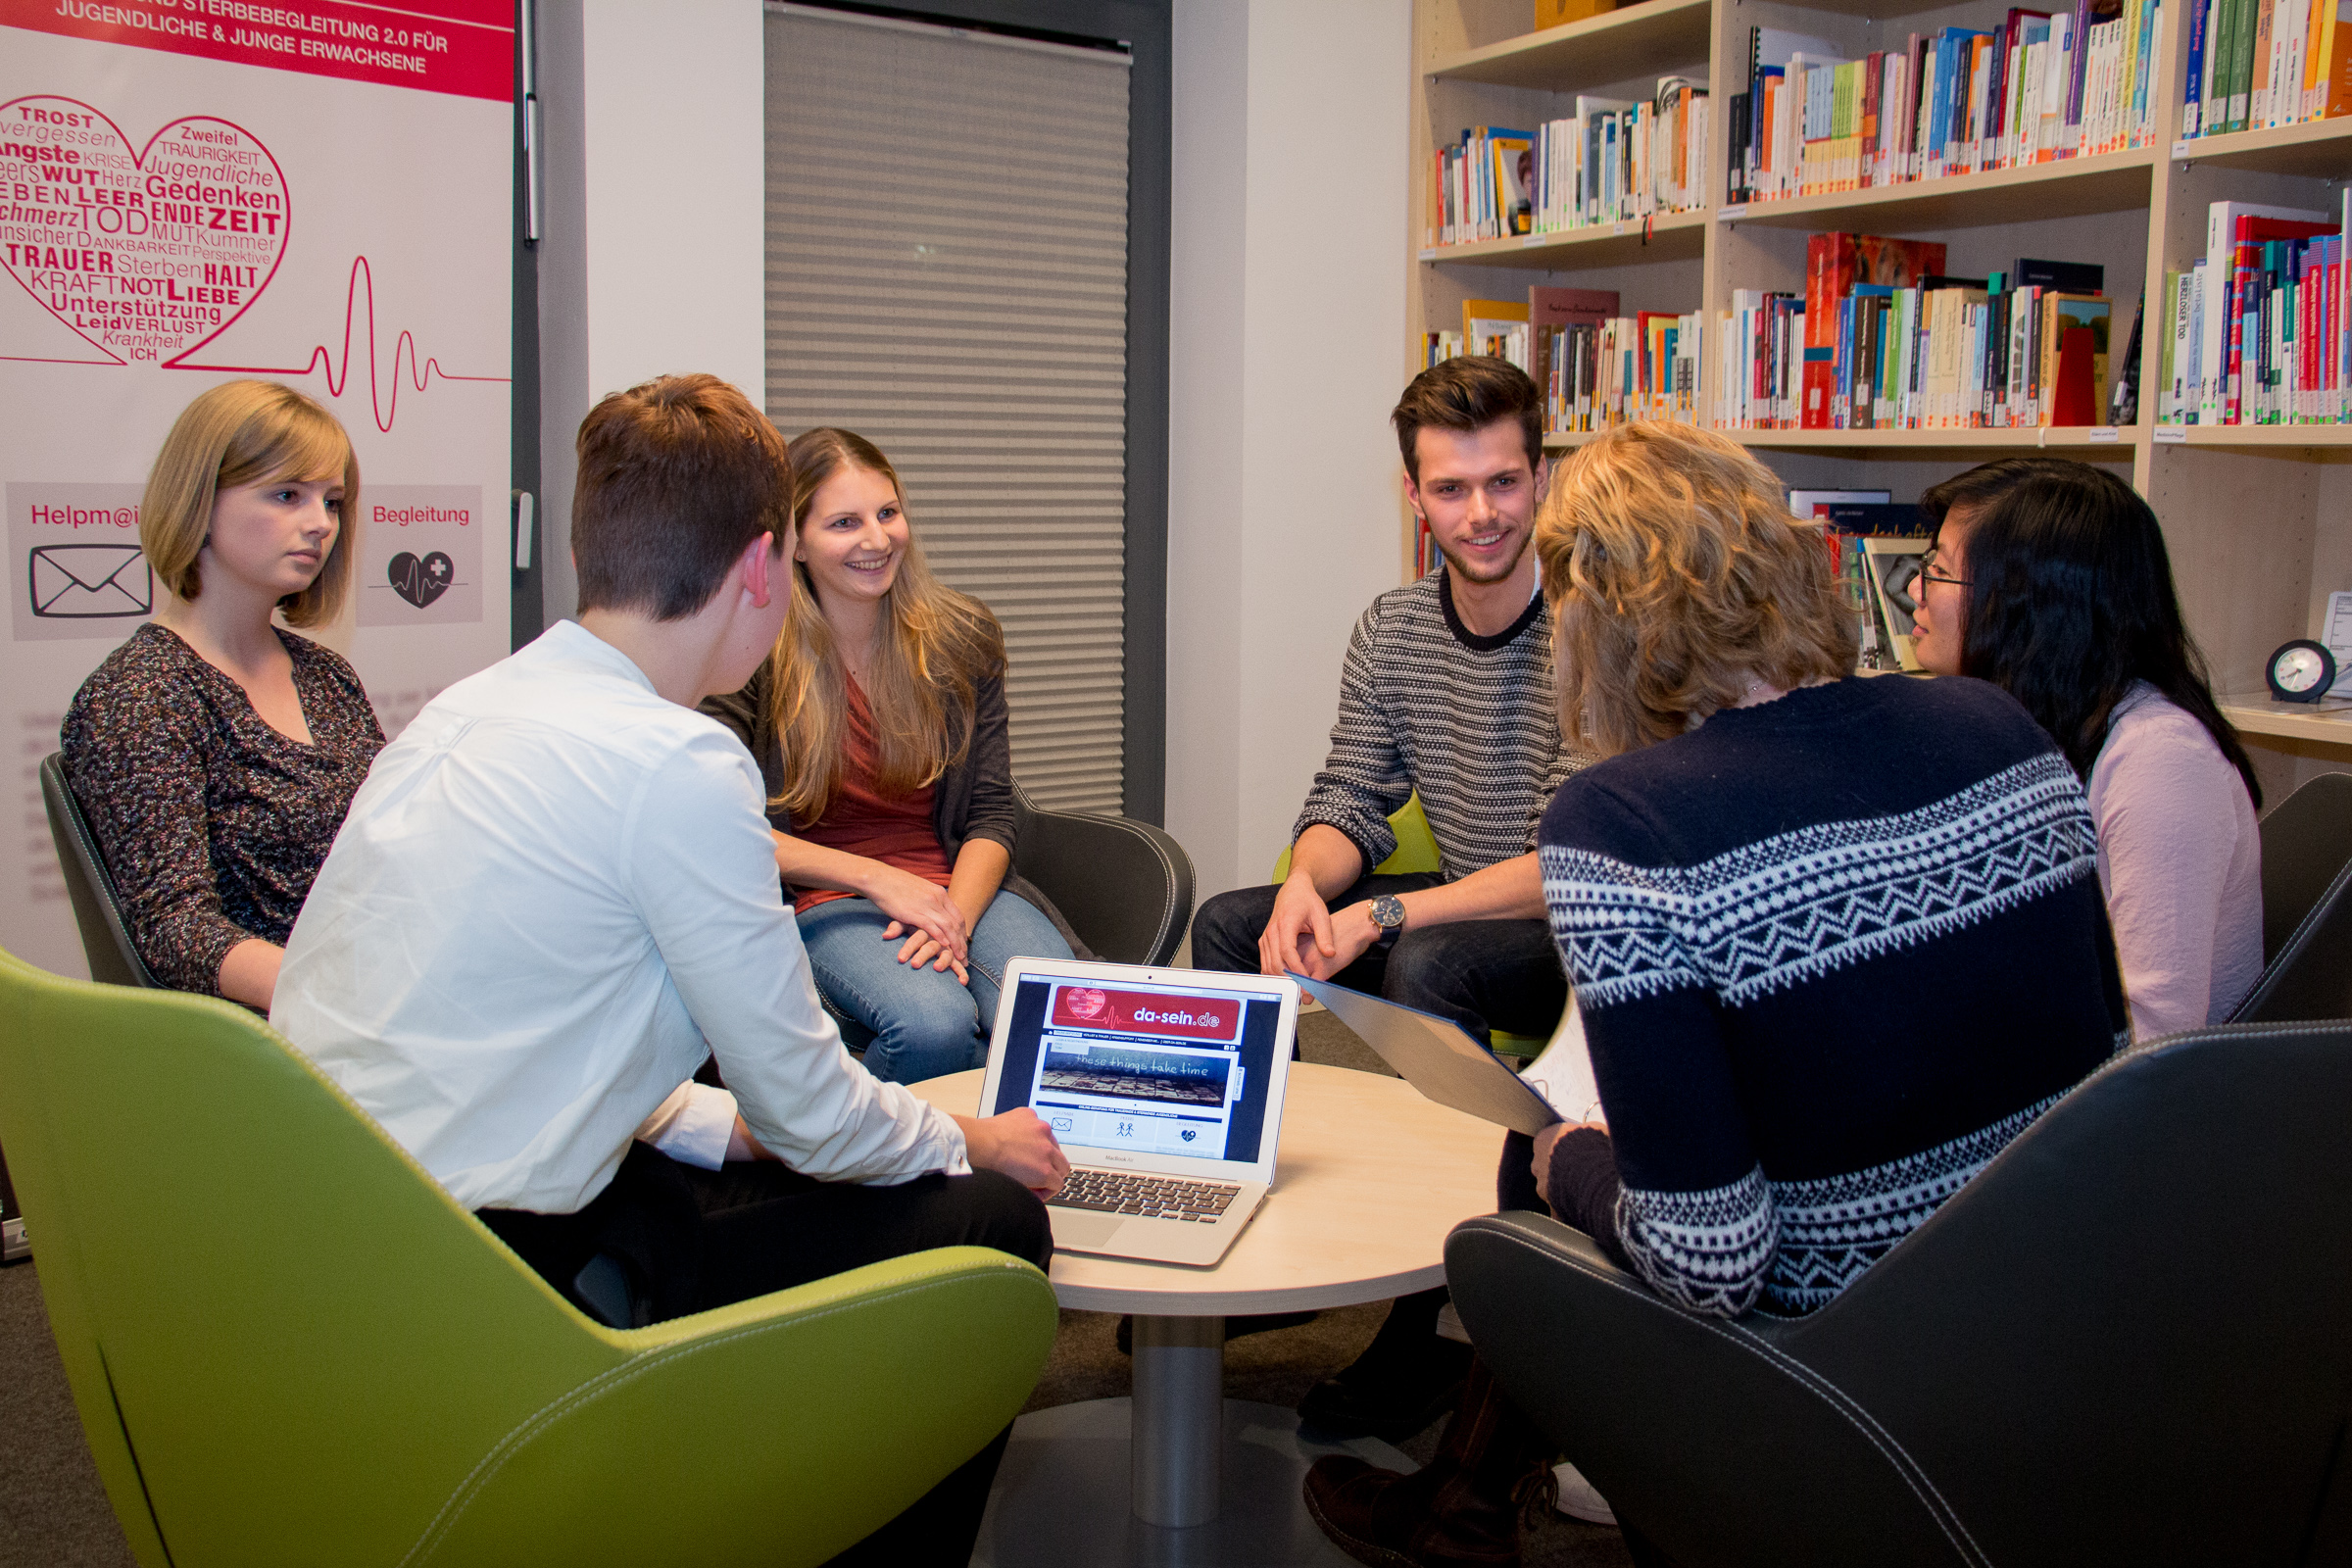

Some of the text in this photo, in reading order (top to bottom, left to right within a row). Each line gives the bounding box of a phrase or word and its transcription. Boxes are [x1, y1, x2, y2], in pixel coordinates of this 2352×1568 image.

[56, 1, 427, 74] JUGENDLICHE & JUNGE ERWACHSENE
[182, 0, 448, 54] STERBEBEGLEITUNG 2.0 FÜR
[19, 106, 94, 128] TROST
[0, 122, 116, 147] vergessen
[181, 126, 238, 146] Zweifel
[83, 153, 131, 171] KRISE
[160, 140, 261, 166] TRAURIGKEIT
[42, 166, 99, 186] WUT
[102, 170, 141, 189] Herz
[145, 155, 273, 187] Jugendliche
[77, 187, 144, 208] LEER
[147, 175, 280, 211] Gedenken
[74, 204, 148, 235] TOD
[152, 201, 204, 225] ENDE
[208, 208, 281, 235] ZEIT
[0, 222, 275, 257] nsicher DANKBARKEIT MUT Kummer
[6, 243, 270, 278] TRAUER Sterben Perspektive
[31, 270, 240, 305] KRAFT NOT LIEBE
[204, 264, 258, 288] HALT
[51, 292, 220, 325] Unterstützung
[2178, 276, 2189, 340] HERZLOSER TOD
[75, 314, 205, 334] Leid VERLUST
[102, 330, 183, 349] Krankheit
[129, 348, 158, 361] ICH
[31, 505, 139, 529] Helpm@i
[372, 505, 469, 526] Begleitung
[1134, 1007, 1220, 1028] da-sein.de
[1076, 1054, 1208, 1076] these things take time
